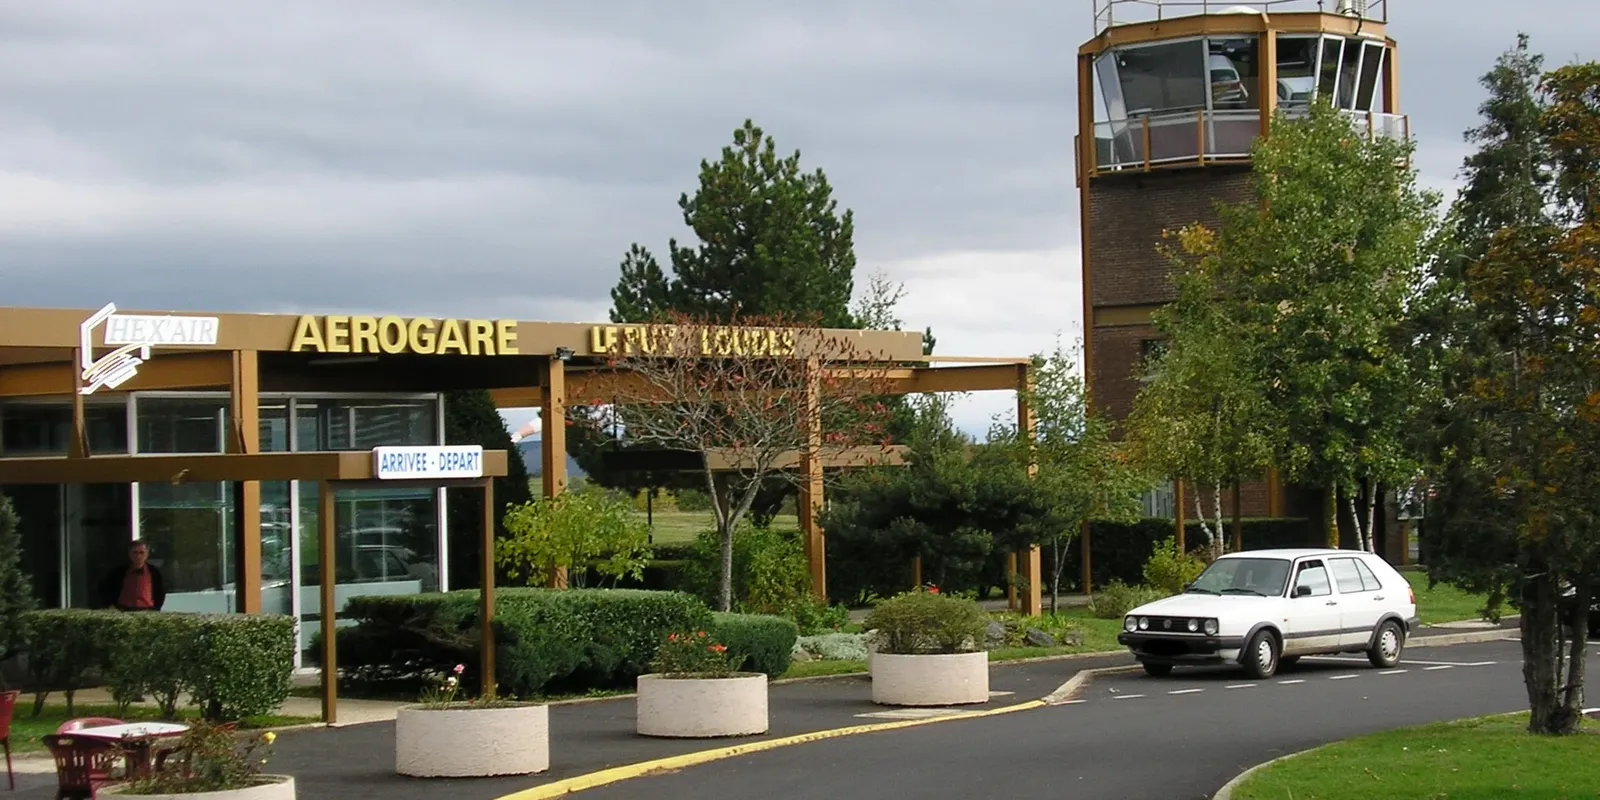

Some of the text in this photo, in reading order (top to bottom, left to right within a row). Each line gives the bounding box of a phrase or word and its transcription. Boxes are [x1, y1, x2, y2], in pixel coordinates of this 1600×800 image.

[108, 317, 215, 342] HEX'AIR
[290, 314, 520, 356] AEROGARE
[592, 325, 618, 353] LE
[380, 452, 428, 472] ARRIVEE
[439, 452, 480, 471] DEPART
